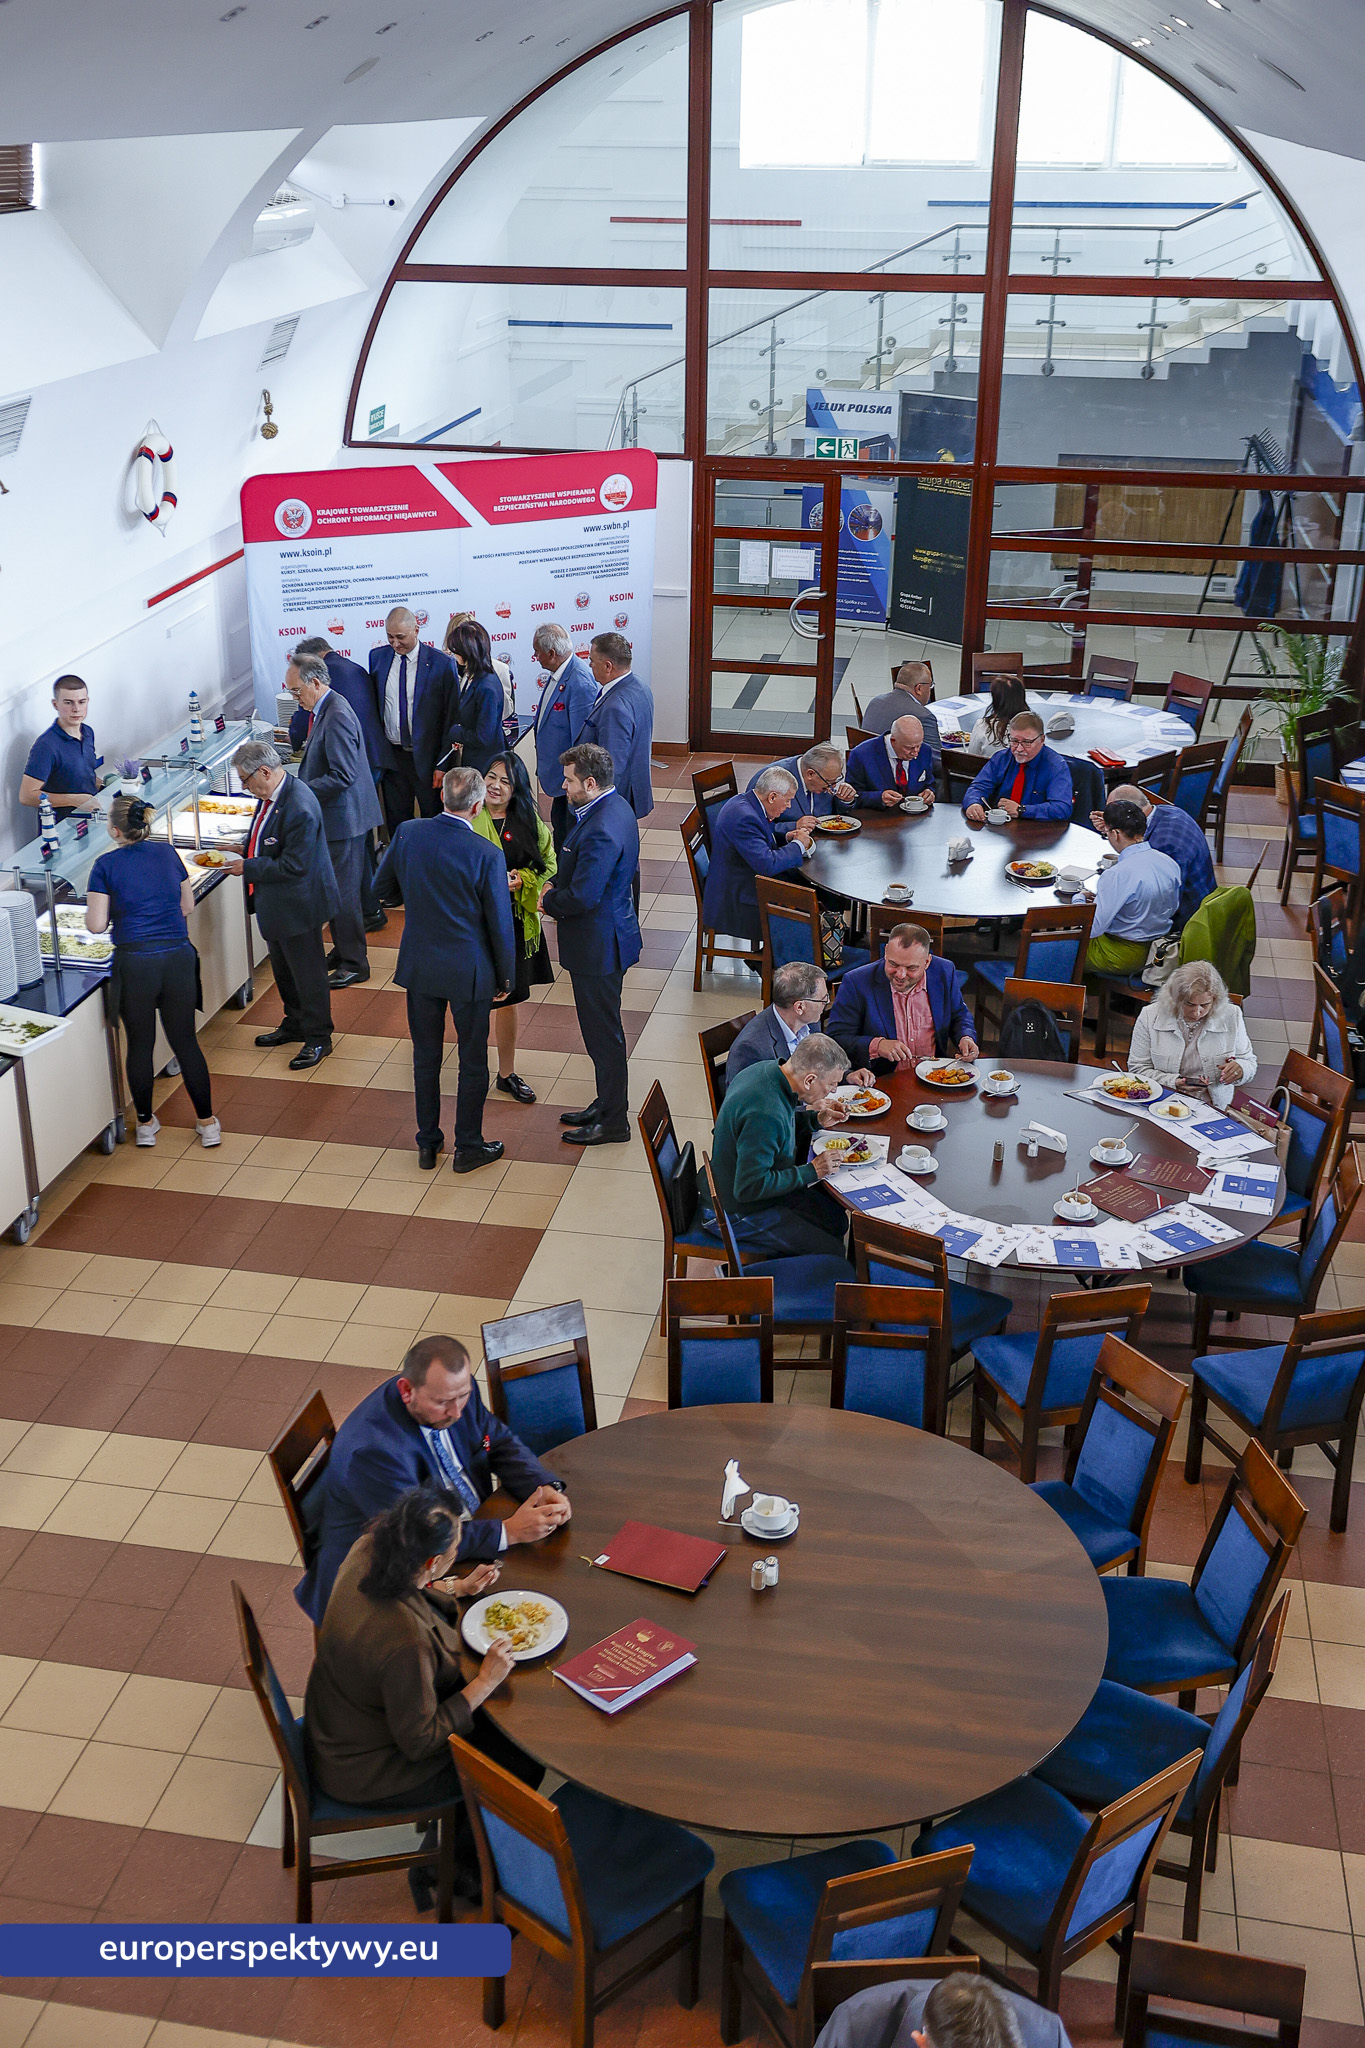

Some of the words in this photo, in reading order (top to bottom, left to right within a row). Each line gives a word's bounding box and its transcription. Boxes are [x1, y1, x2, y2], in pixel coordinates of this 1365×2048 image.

[812, 402, 845, 412] JELUX
[847, 403, 892, 414] POLSKA
[500, 492, 556, 503] STOWARZYSZENIE
[557, 488, 595, 497] WSPIERANIA
[493, 500, 548, 512] BEZPIECZEŃSTWA
[549, 496, 595, 506] NARODOWEGO
[317, 508, 348, 516] KRAJOWE
[350, 504, 409, 514] STOWARZYSZENIE
[352, 514, 393, 523] INFORMACJI
[394, 511, 437, 520] NIEJAWNYCH
[584, 520, 630, 532] www.swbn.pl
[280, 547, 332, 558] www.ksoin.pl
[609, 592, 634, 602] KSOIN
[530, 602, 555, 612] SWBN
[366, 620, 385, 628] SWB
[570, 622, 594, 632] SWBN
[278, 626, 306, 636] KSOIN
[491, 632, 516, 642] KSOIN
